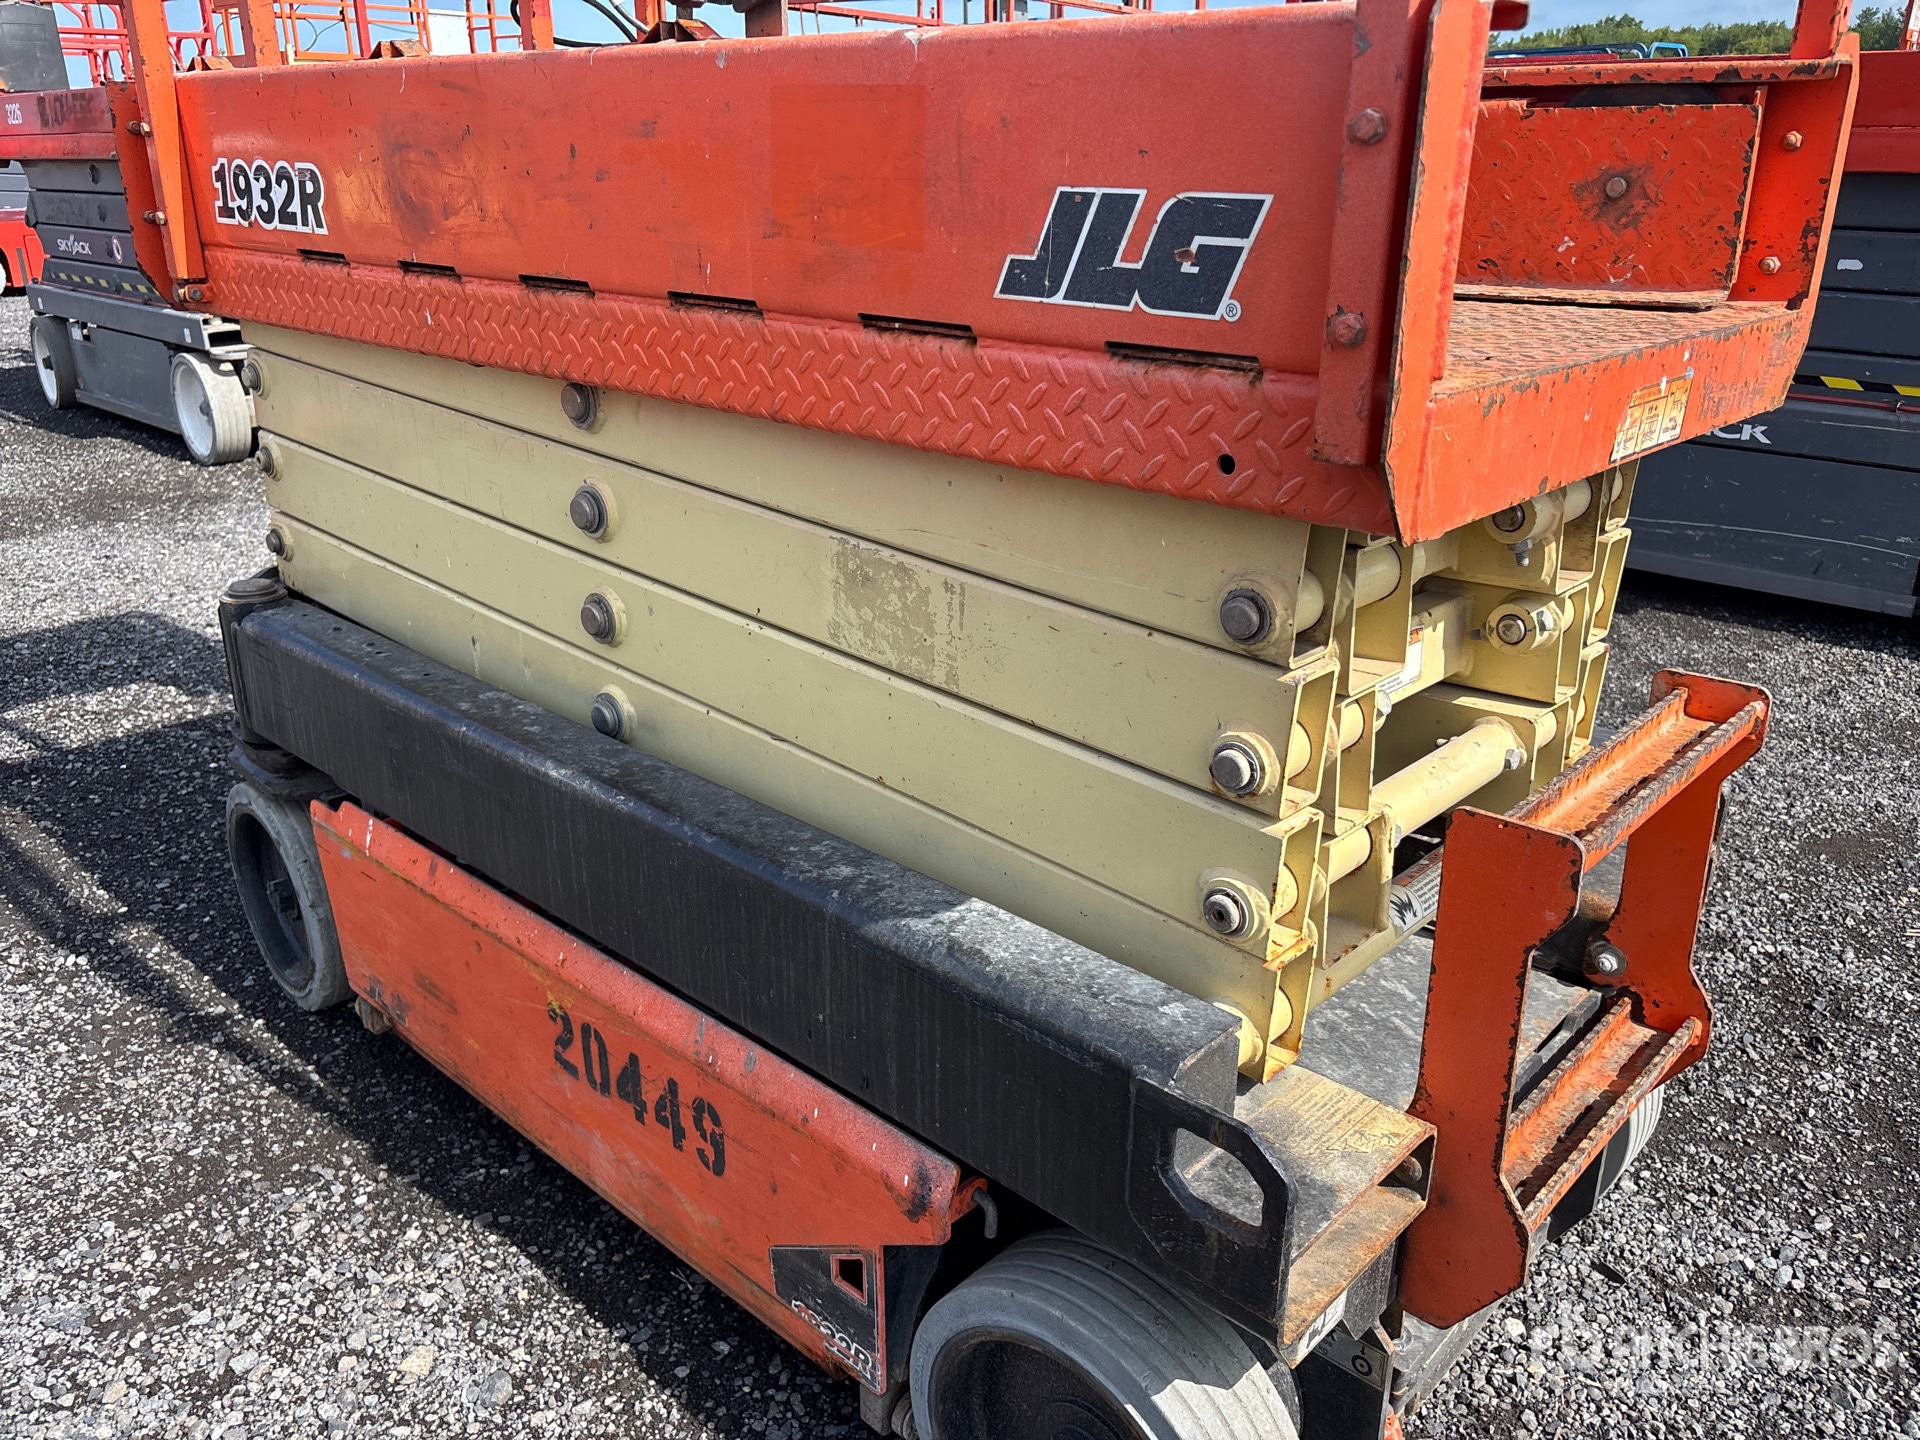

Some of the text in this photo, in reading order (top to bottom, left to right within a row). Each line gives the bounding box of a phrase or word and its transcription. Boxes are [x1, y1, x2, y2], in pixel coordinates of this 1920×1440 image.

[5, 103, 22, 125] 3226
[212, 157, 329, 235] 1932R
[57, 234, 92, 255] SKYJACK
[994, 186, 1274, 321] JLG
[547, 1001, 726, 1177] 20449
